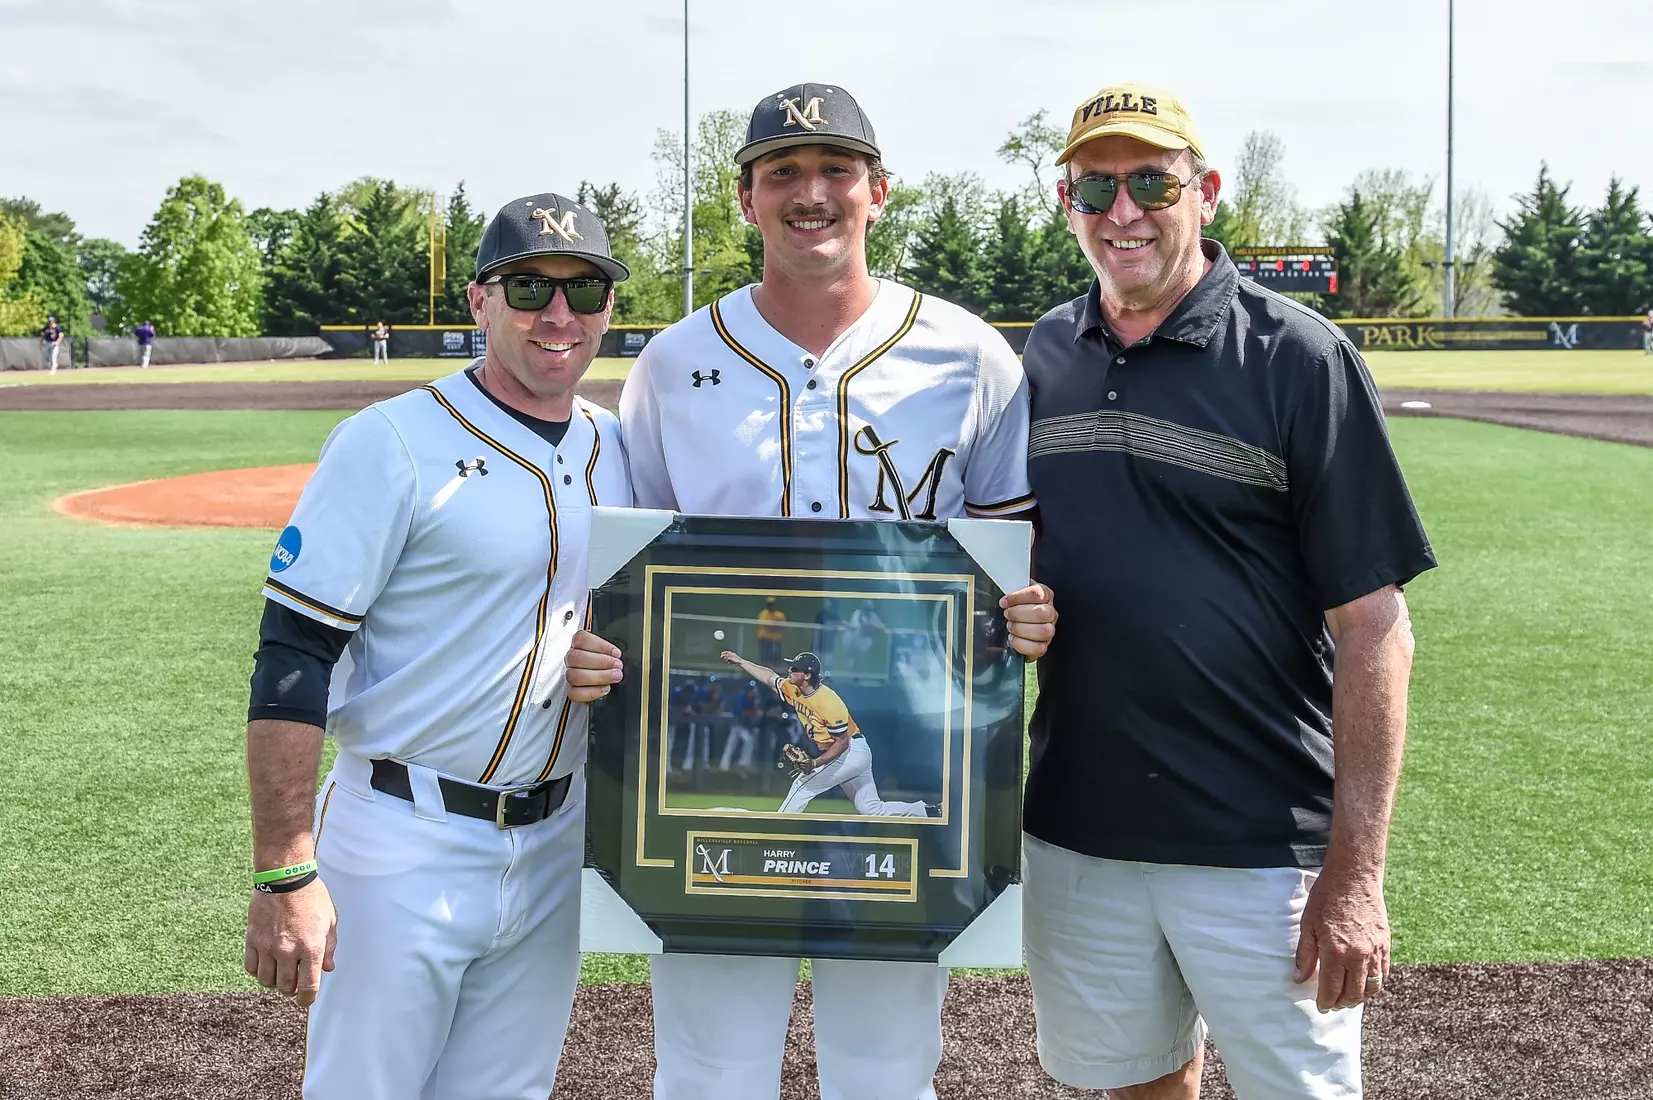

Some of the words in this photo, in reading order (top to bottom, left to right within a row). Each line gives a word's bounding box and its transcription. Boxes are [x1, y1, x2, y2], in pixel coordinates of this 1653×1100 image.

[1083, 93, 1157, 122] VILLE
[1357, 325, 1446, 348] PARK
[763, 850, 796, 858] HARRY
[865, 853, 896, 878] 14
[763, 859, 831, 875] PRINCE
